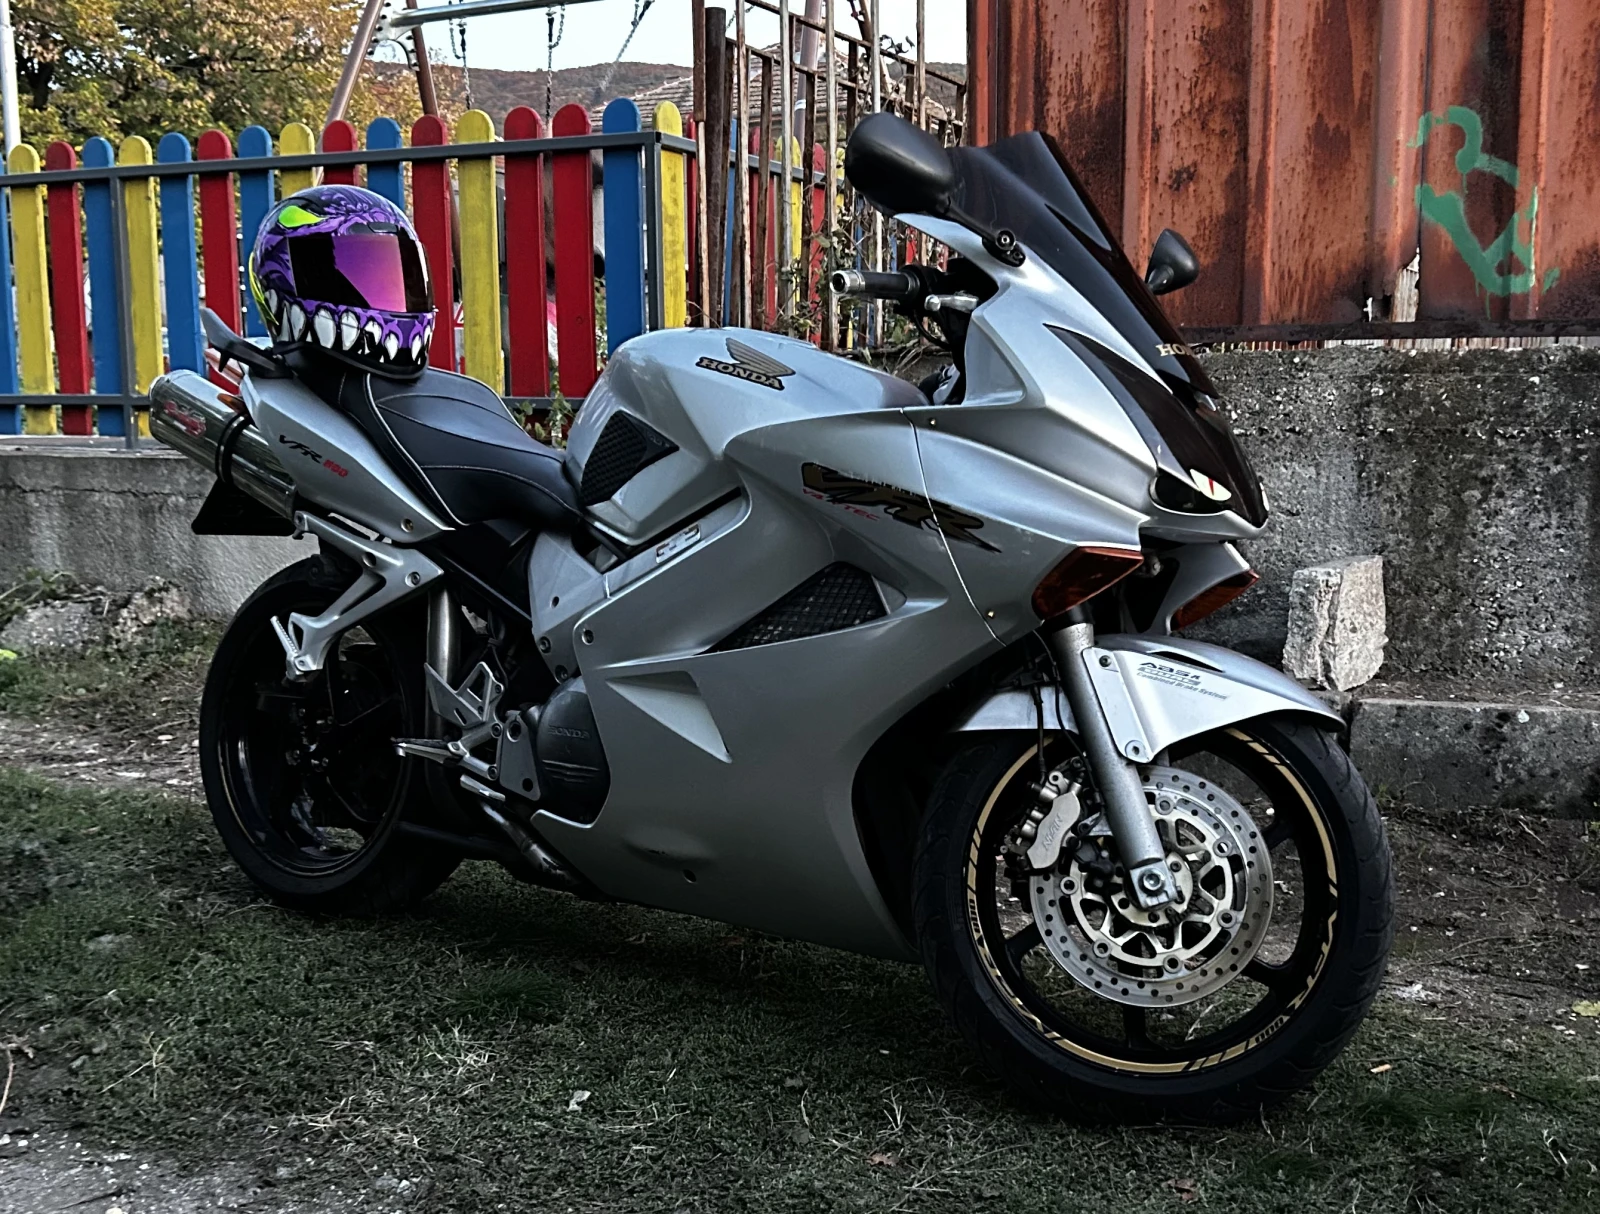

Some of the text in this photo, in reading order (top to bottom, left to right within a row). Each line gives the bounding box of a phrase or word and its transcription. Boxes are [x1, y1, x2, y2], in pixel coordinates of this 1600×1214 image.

[696, 356, 784, 390] HONDA
[279, 434, 322, 464] VFR
[801, 462, 1001, 554] VFR
[549, 725, 590, 739] HONDA
